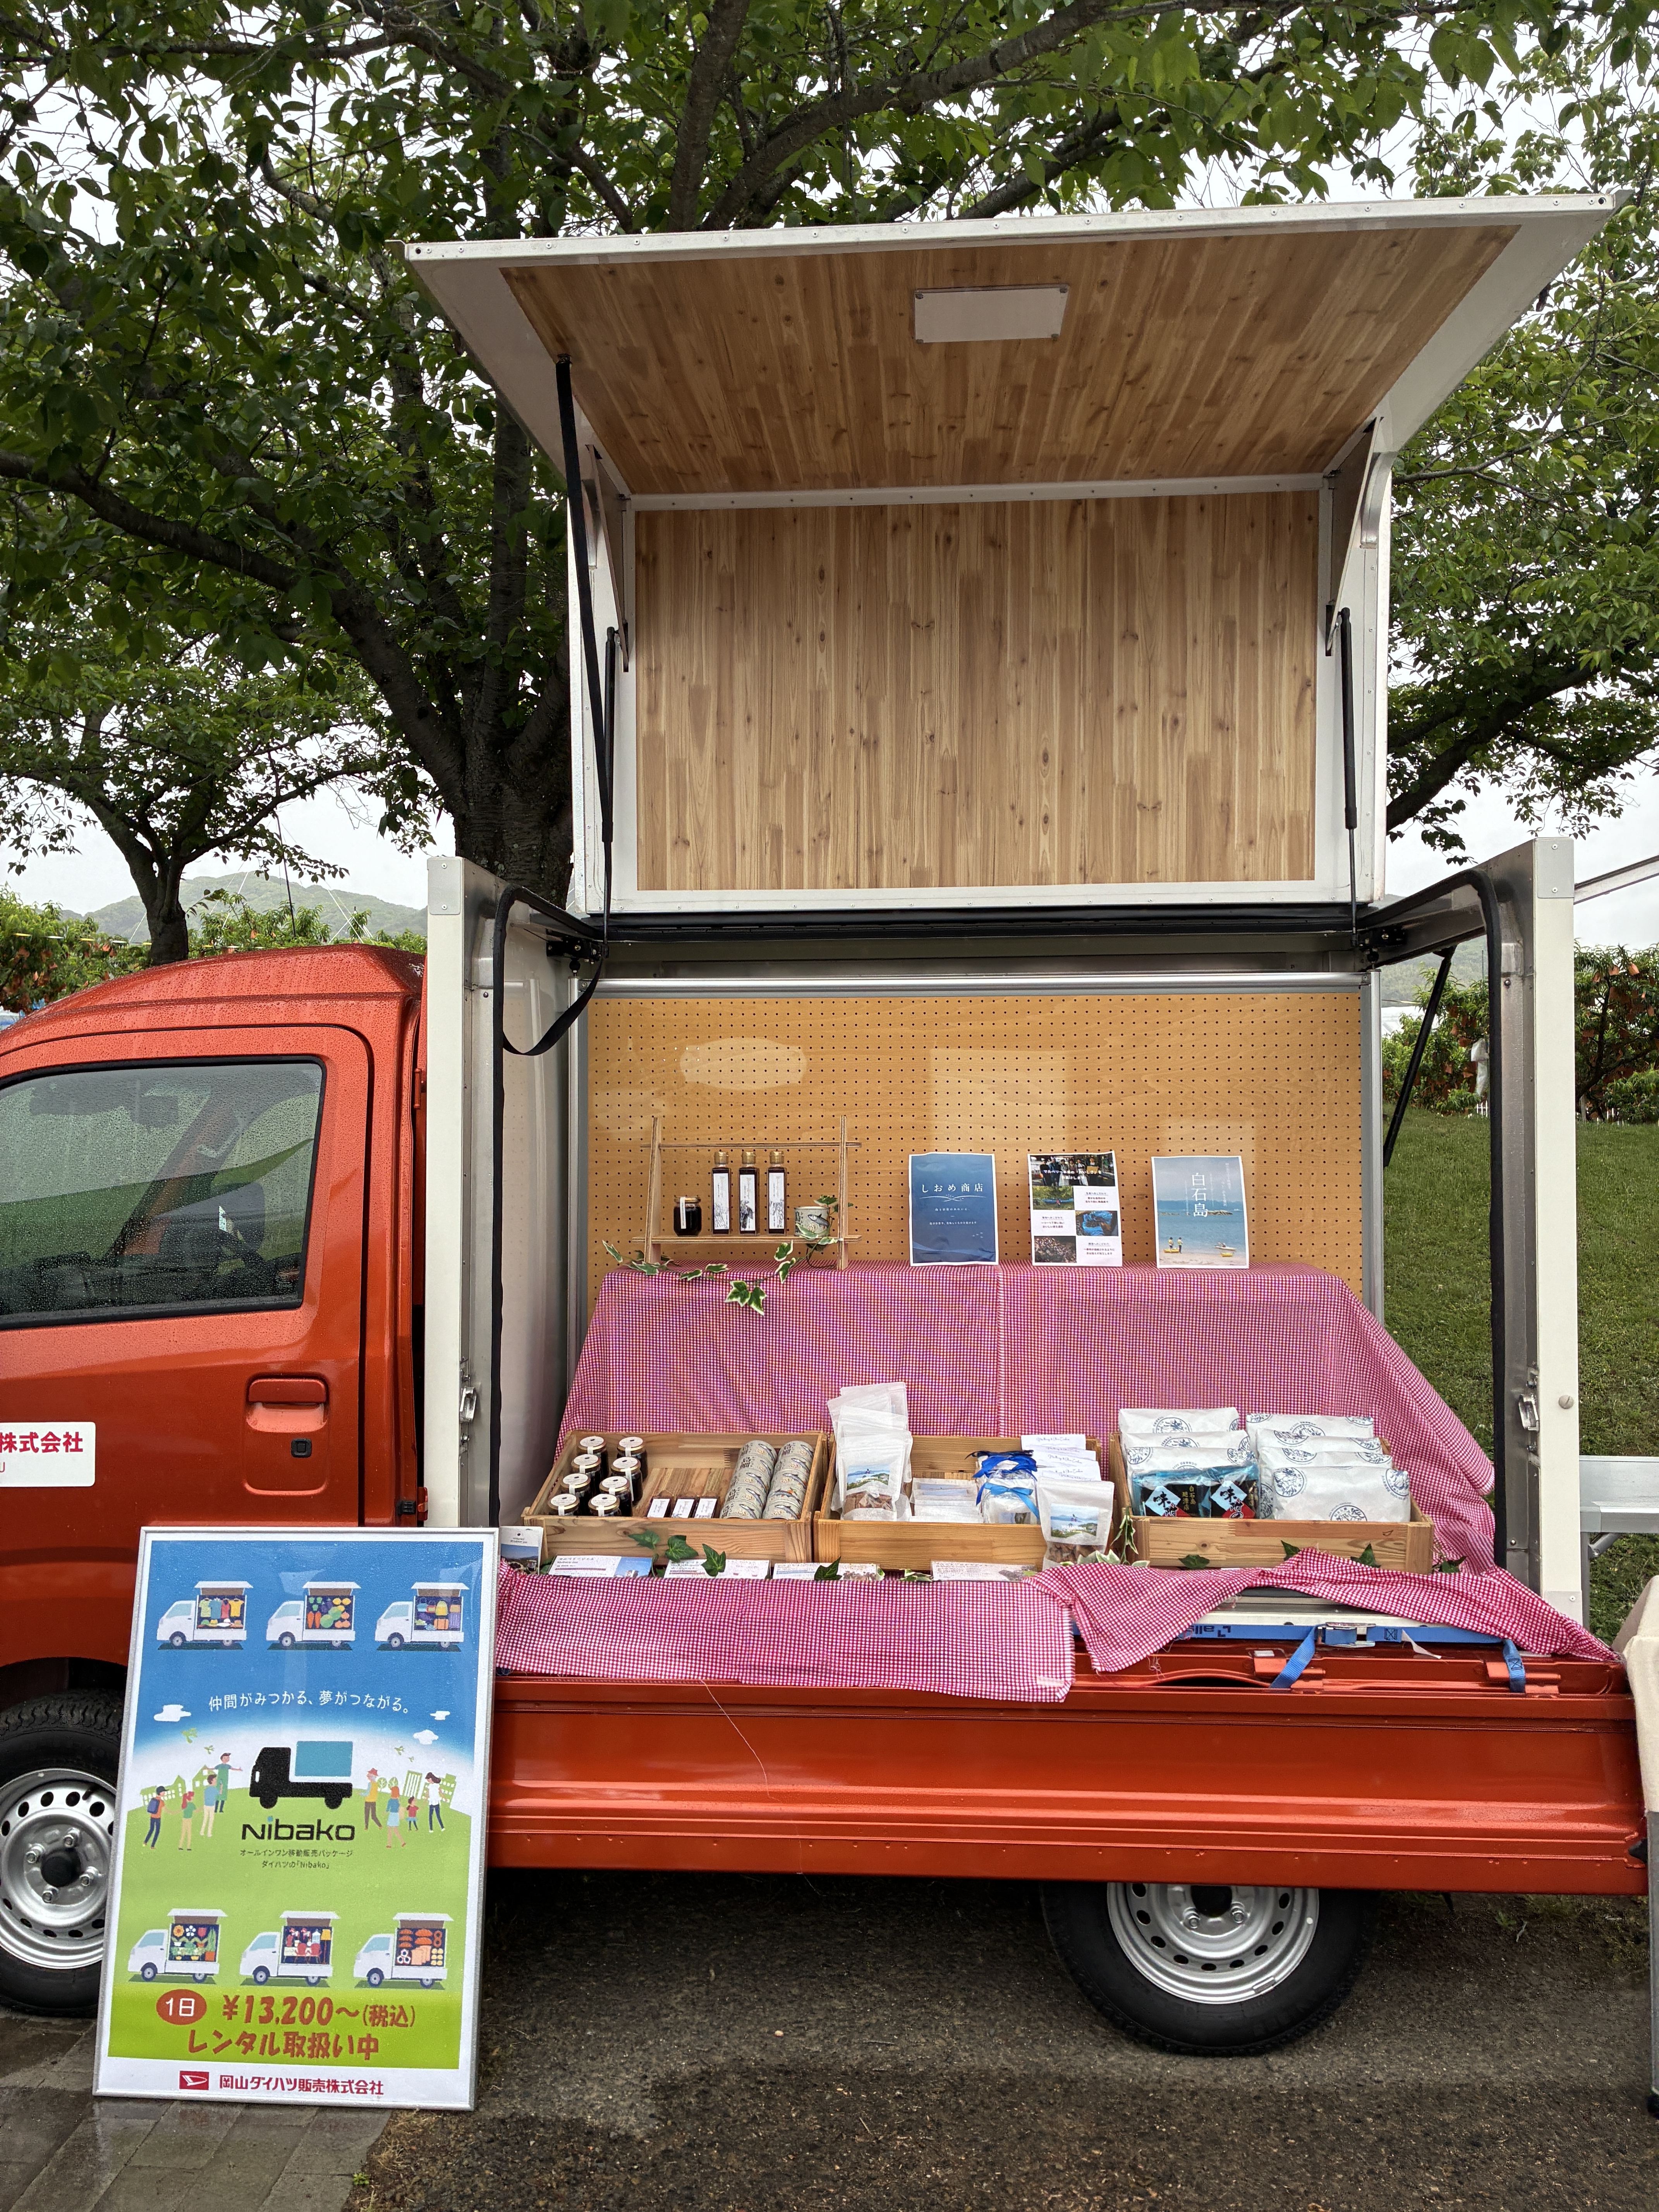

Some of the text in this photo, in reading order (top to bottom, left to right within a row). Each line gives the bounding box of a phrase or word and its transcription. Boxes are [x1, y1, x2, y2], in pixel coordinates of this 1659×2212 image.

[922, 1183, 983, 1193] しおめ商店
[1191, 1173, 1208, 1217] 白石島
[209, 1690, 408, 1713] 仲間がみつかる、夢がつながる。
[242, 1815, 355, 1840] Nibako
[240, 1849, 352, 1857] オールインワン移動販売パッケージ
[262, 1860, 329, 1869] ダイハツの「Nibako」
[166, 1997, 195, 2017] 1日
[189, 2029, 379, 2060] レンタル取扱い中
[219, 2075, 384, 2095] 岡山ダイハツ販売株式会社
